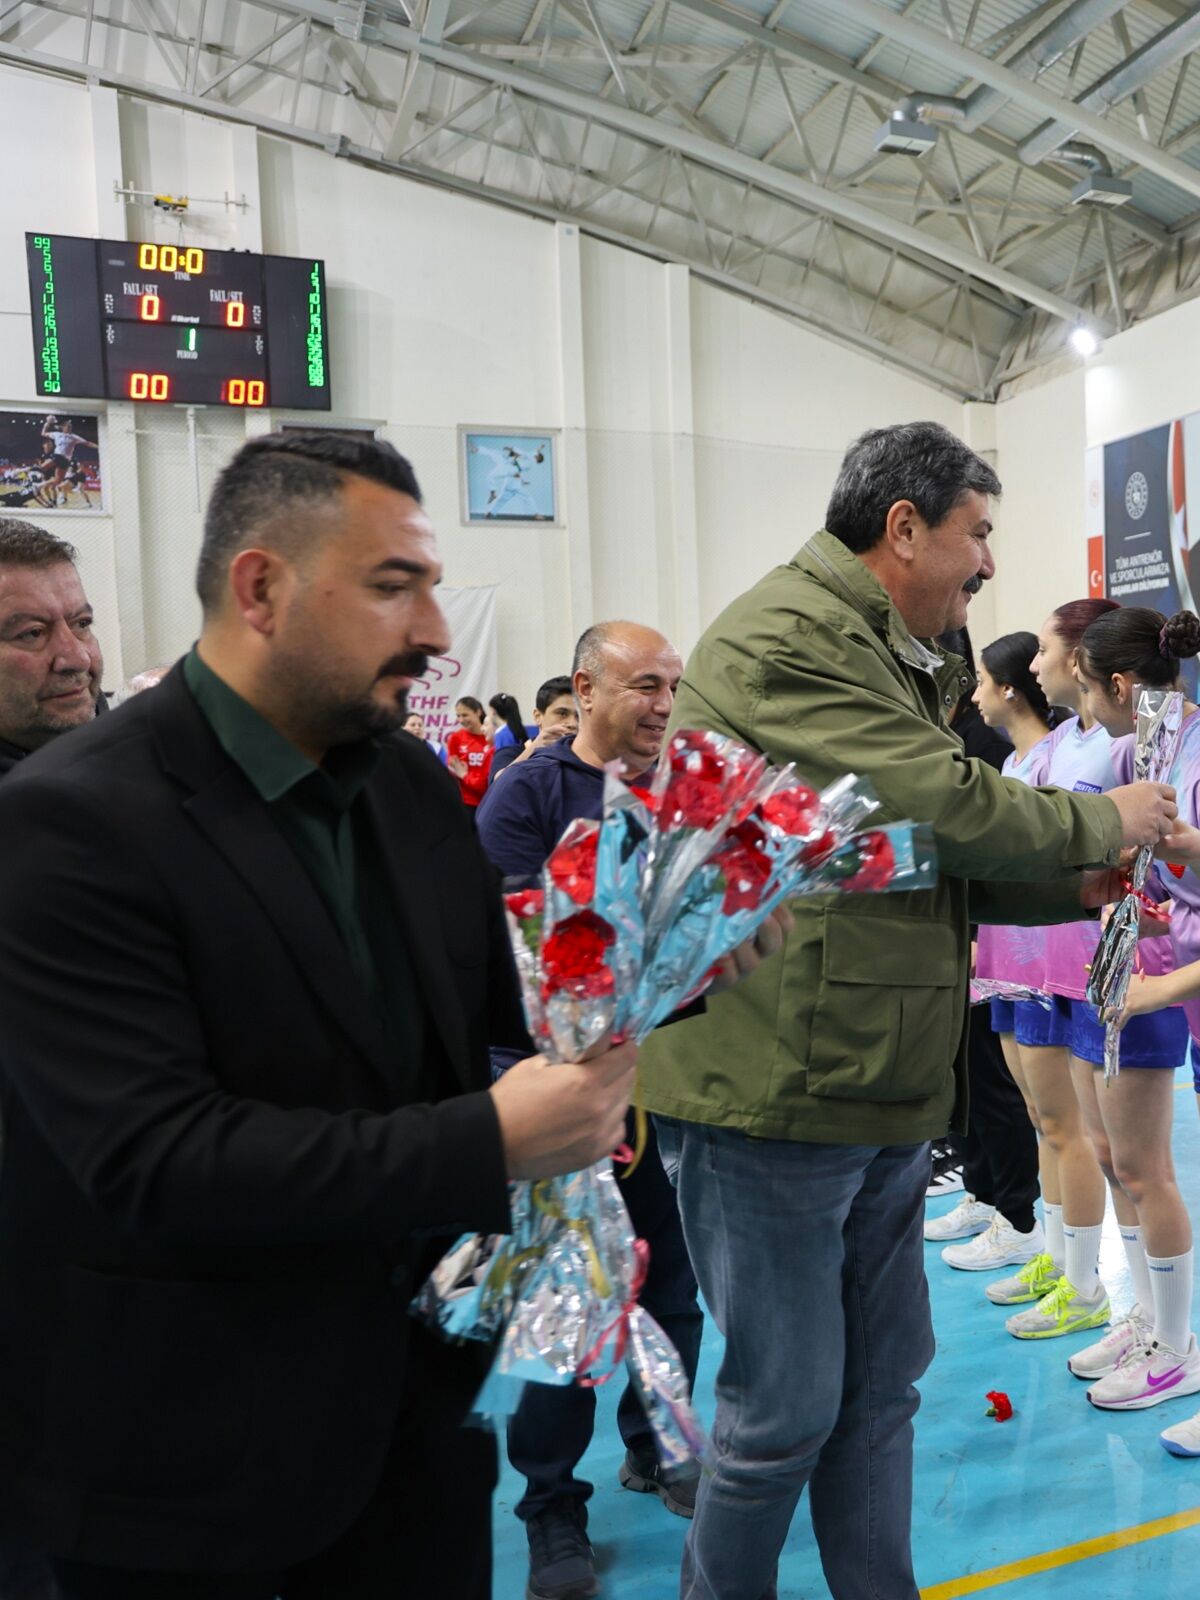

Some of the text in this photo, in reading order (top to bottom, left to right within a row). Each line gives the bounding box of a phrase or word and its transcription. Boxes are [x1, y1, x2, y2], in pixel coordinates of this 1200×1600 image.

[34, 237, 51, 249] 99
[43, 249, 51, 260] 5
[140, 244, 203, 274] 00:0
[44, 260, 52, 271] 6
[45, 282, 54, 293] 9
[43, 304, 55, 316] 15
[141, 295, 159, 321] 0
[227, 302, 245, 327] 0
[45, 315, 56, 327] 16
[188, 328, 197, 351] 1
[130, 373, 168, 400] 00
[228, 379, 264, 405] 00
[408, 695, 448, 709] THF
